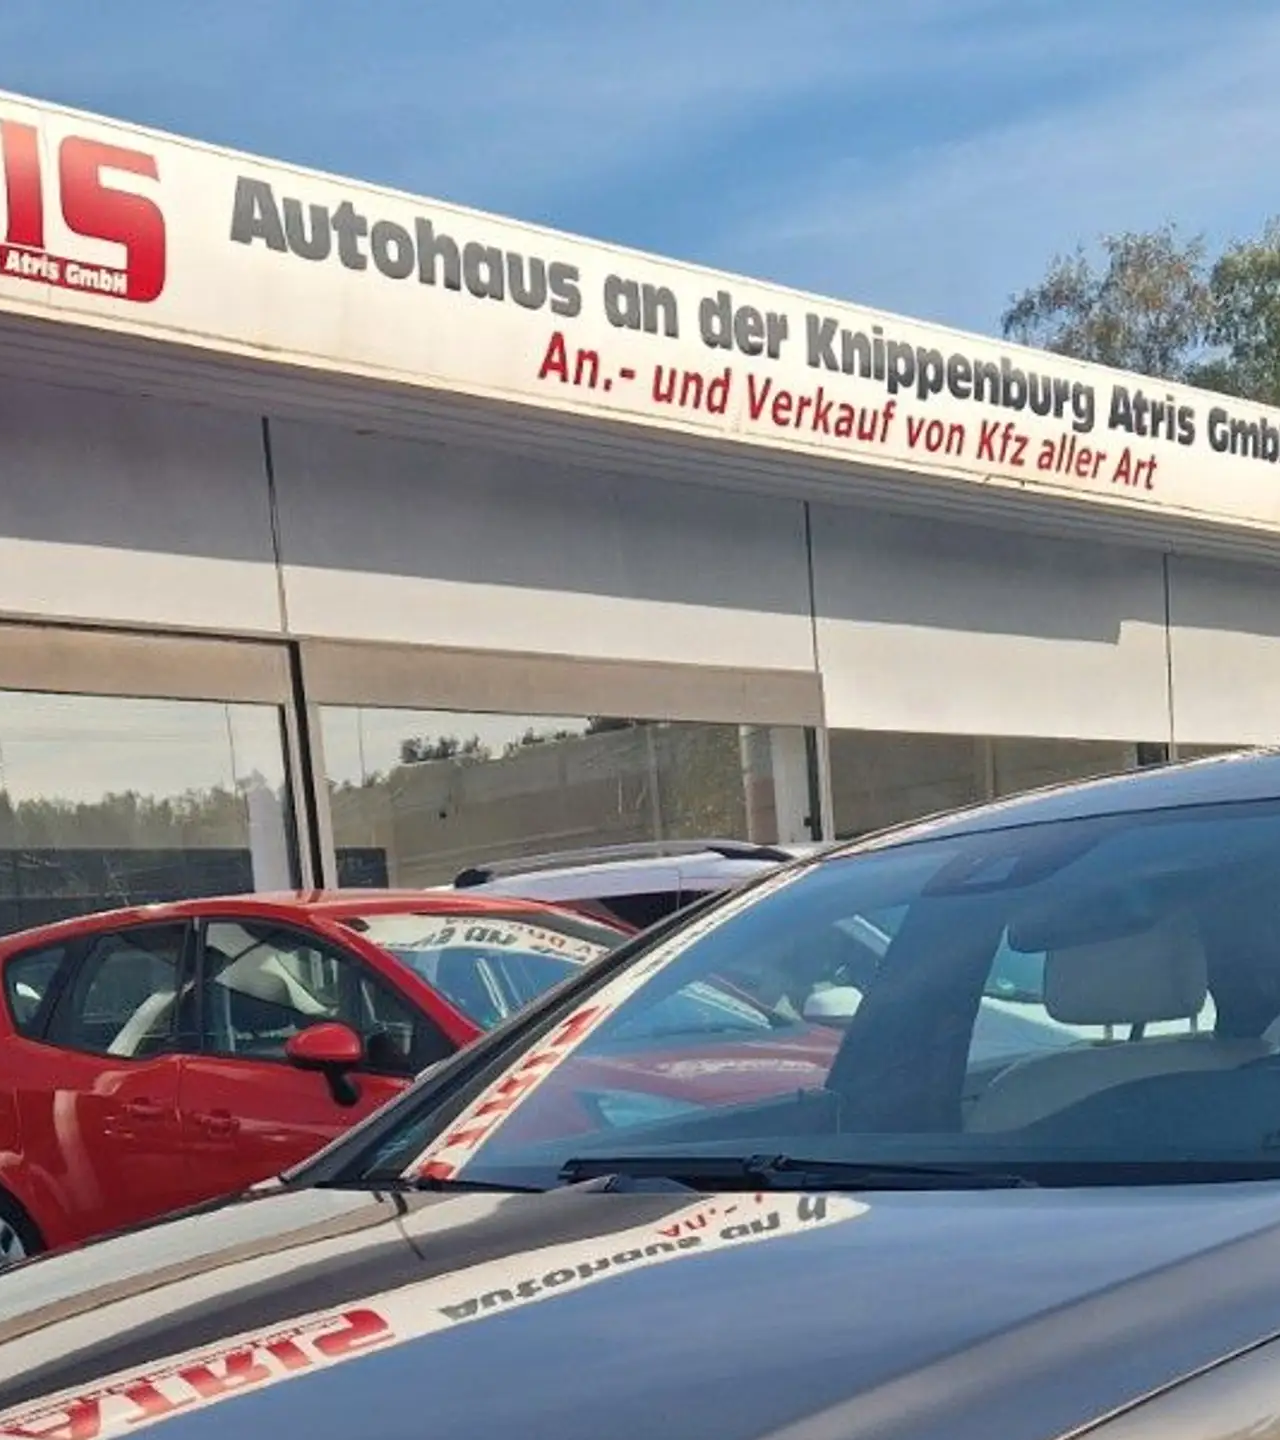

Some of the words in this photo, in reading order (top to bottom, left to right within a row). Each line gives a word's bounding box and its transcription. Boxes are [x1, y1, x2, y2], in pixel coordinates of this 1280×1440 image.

[4, 243, 60, 282] Atris
[65, 262, 129, 296] GmbH
[230, 175, 582, 318] Autohaus
[603, 272, 679, 339] an
[699, 290, 788, 360] der
[805, 312, 1096, 434] Knippenburg
[1108, 385, 1196, 447] Atris
[538, 330, 637, 391] An.-
[651, 365, 733, 416] und
[747, 374, 896, 443] Verkauf
[906, 417, 965, 457] von
[977, 418, 1030, 467] Kfz
[1036, 431, 1107, 482] aller
[1111, 446, 1159, 492] Art
